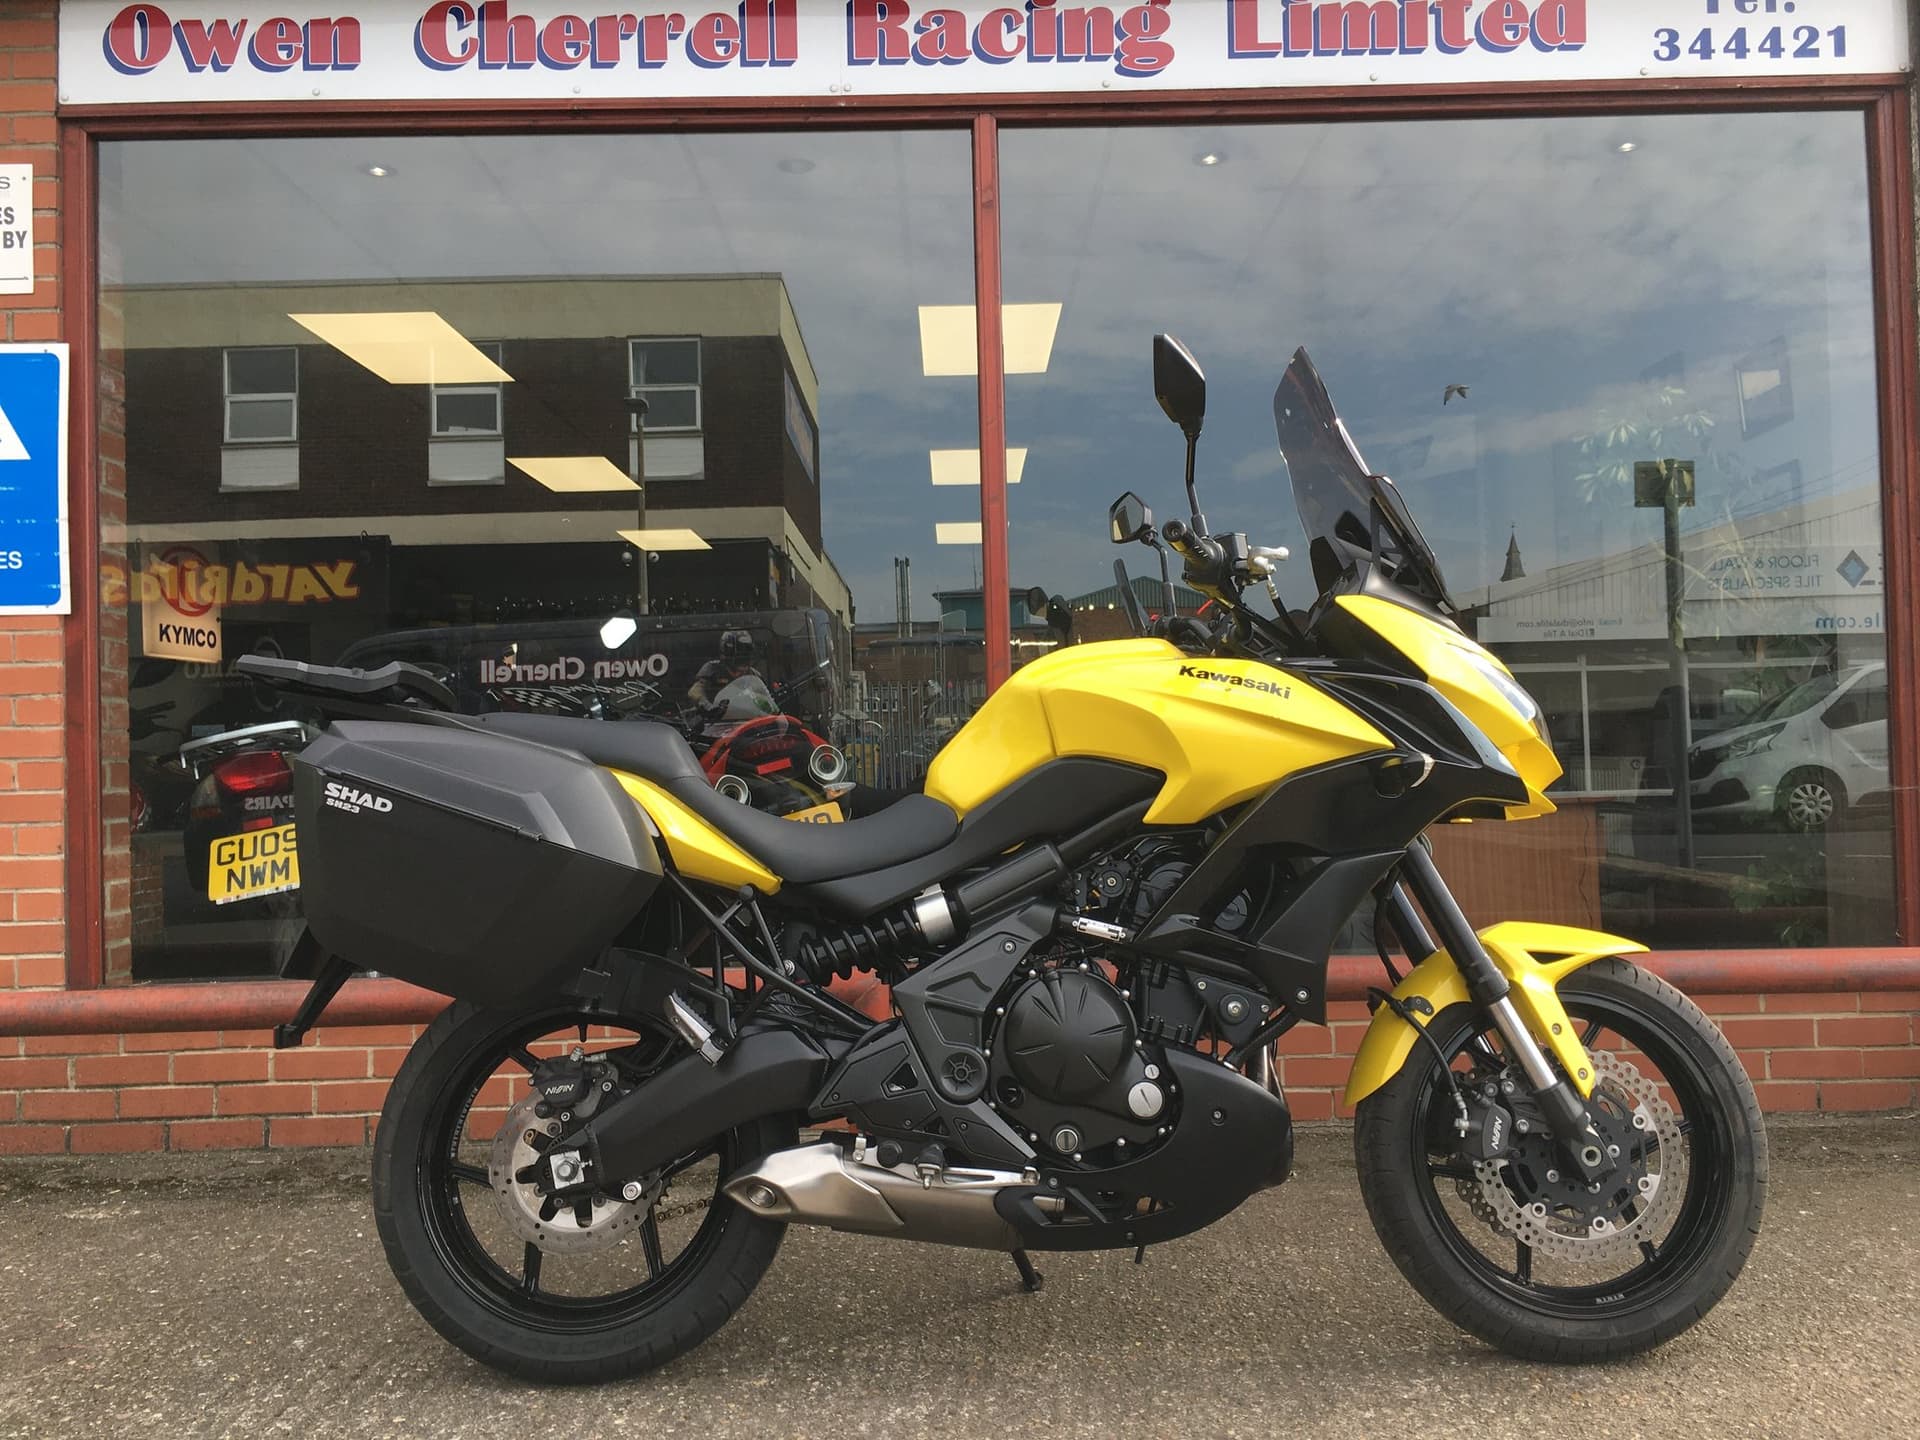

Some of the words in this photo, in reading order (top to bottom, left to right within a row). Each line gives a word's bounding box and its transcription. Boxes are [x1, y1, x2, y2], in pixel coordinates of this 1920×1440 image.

[102, 3, 362, 76] Owen
[414, 0, 798, 71] Cherrell
[847, 0, 1175, 78] Racing
[1228, 0, 1588, 60] Limited
[1653, 25, 1847, 61] 344421
[3, 230, 28, 249] BY
[158, 622, 218, 649] KYMCO
[1178, 665, 1292, 700] Kawasaki
[323, 782, 393, 814] SHAD
[325, 798, 361, 815] SH23
[226, 856, 290, 893] NWM
